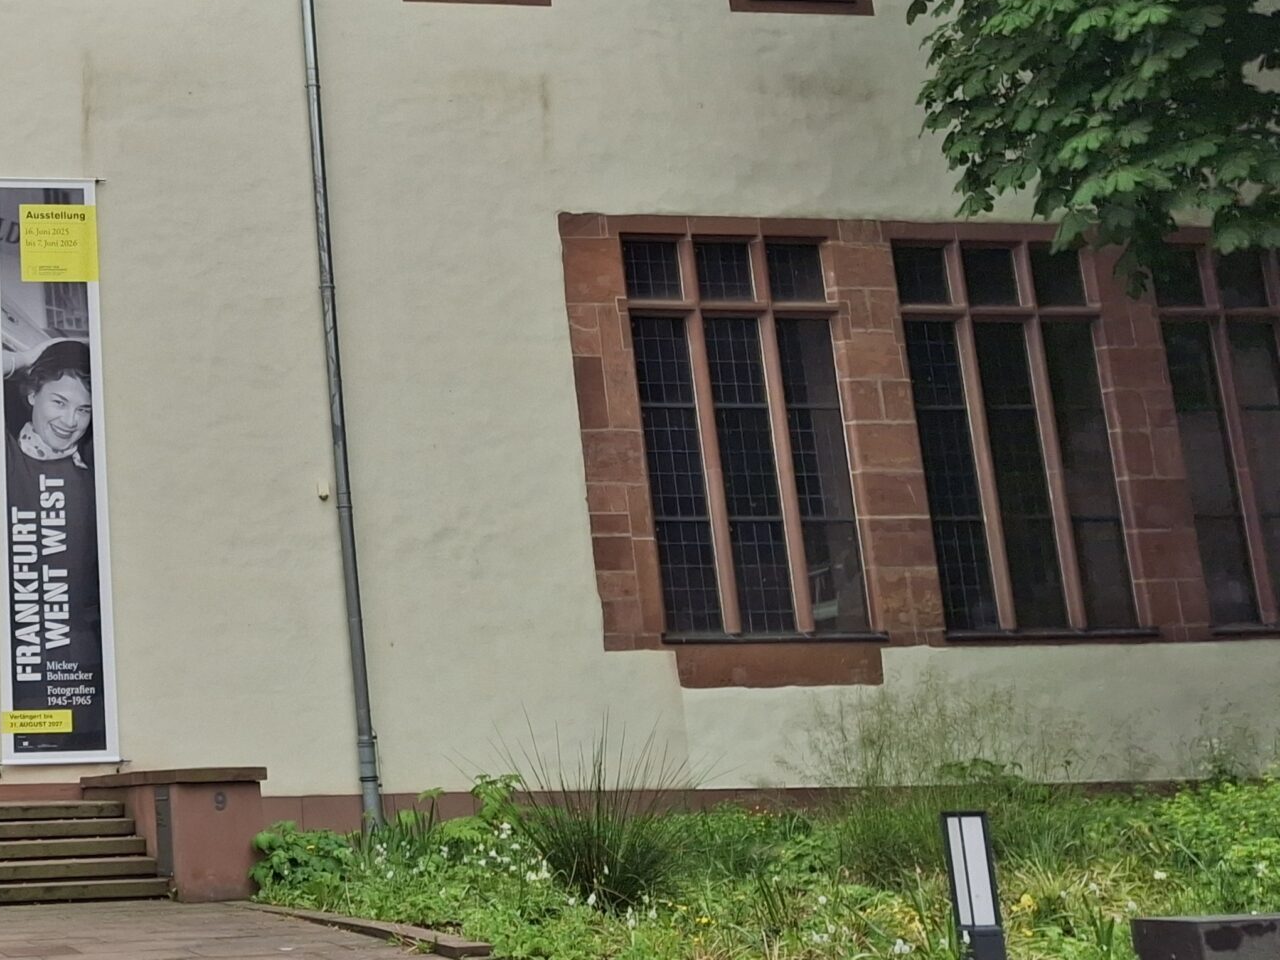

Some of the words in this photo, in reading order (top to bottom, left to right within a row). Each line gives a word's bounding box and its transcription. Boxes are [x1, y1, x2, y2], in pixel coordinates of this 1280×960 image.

[26, 211, 86, 221] Ausstellung
[35, 228, 51, 237] Juni
[52, 228, 70, 236] 2025
[25, 239, 36, 247] bis
[43, 240, 58, 248] Juni
[60, 240, 78, 248] 2026
[39, 474, 66, 556] WEST
[11, 506, 42, 682] FRANKFURT
[42, 565, 70, 649] WENT
[46, 661, 78, 671] Mickey
[46, 672, 93, 681] Bohnacker
[47, 685, 96, 697] Fotografien
[214, 791, 227, 812] 9
